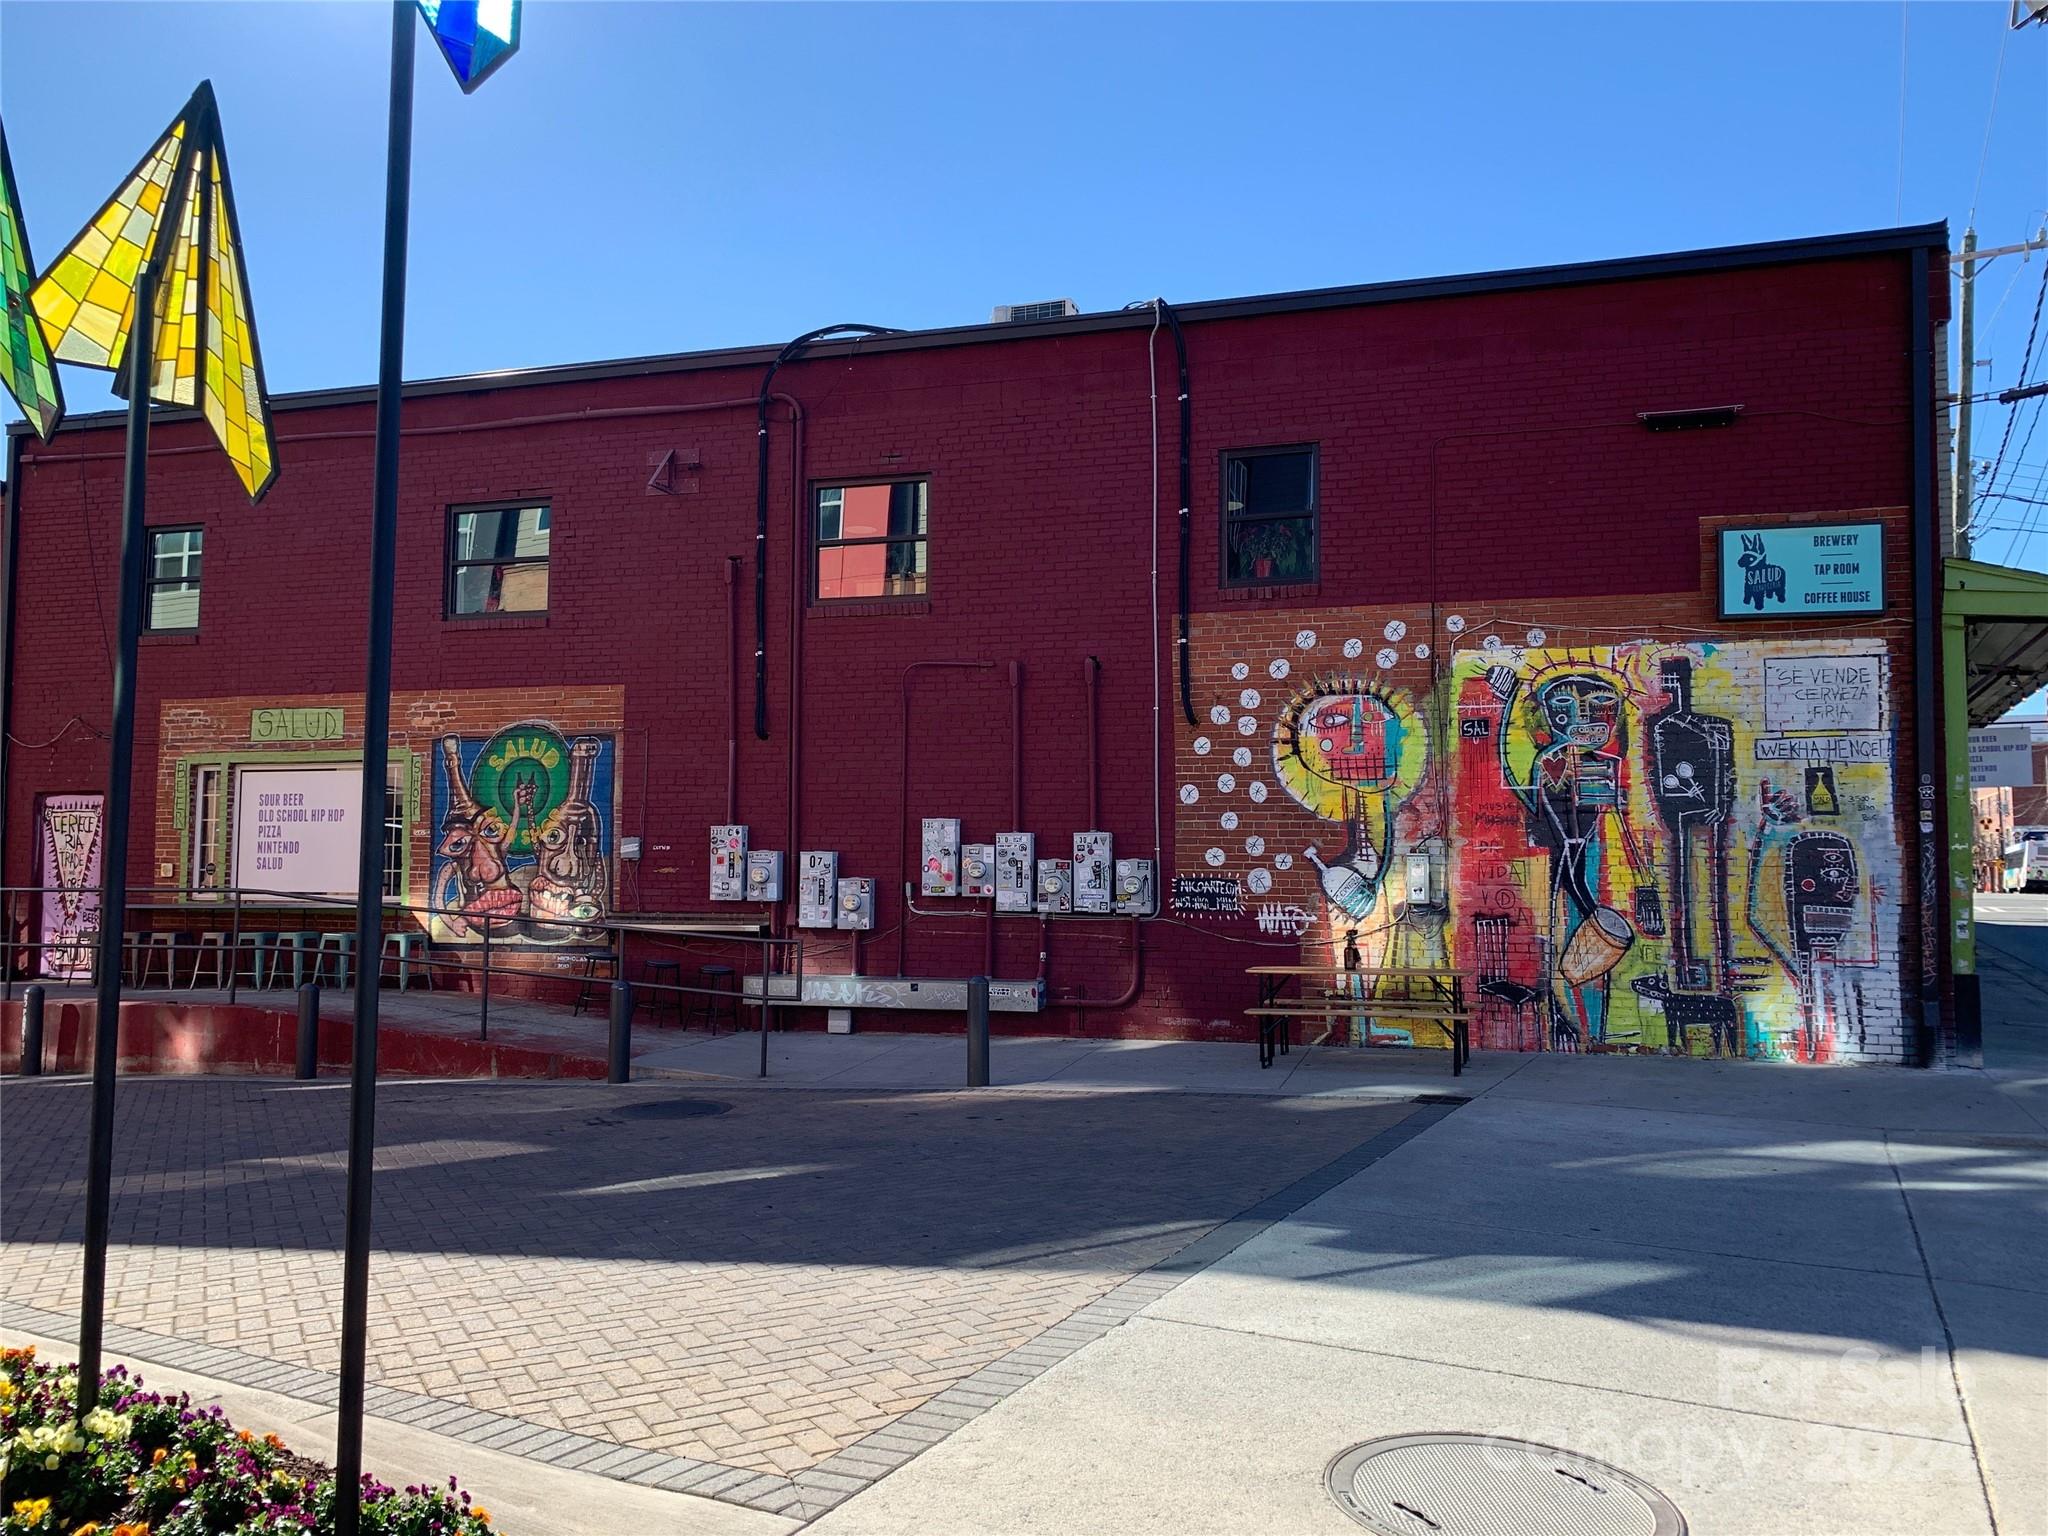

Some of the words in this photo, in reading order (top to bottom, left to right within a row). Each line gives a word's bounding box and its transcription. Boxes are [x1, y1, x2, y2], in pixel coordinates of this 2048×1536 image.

[1813, 534, 1859, 548] BREWERY
[1814, 564, 1831, 576] TAP
[1833, 562, 1860, 575] ROOM
[1748, 568, 1782, 585] SALUD
[1804, 592, 1838, 604] COFFEE
[1840, 590, 1871, 603] HOUSE
[1809, 667, 1872, 686] VENDE
[1793, 685, 1870, 702] CERVEZA
[1812, 705, 1850, 719] FRIA
[257, 710, 338, 739] SALUD
[488, 737, 560, 772] SALUD
[412, 760, 421, 816] SHOP
[259, 793, 281, 807] SOUR
[283, 793, 304, 806] BEER
[258, 809, 275, 822] OLD
[276, 809, 308, 822] SCHOOL
[310, 808, 326, 821] HIP
[328, 808, 345, 821] HOP
[258, 825, 282, 838] PIZZA
[257, 841, 300, 854] NINTENDO
[256, 857, 283, 870] SALUD
